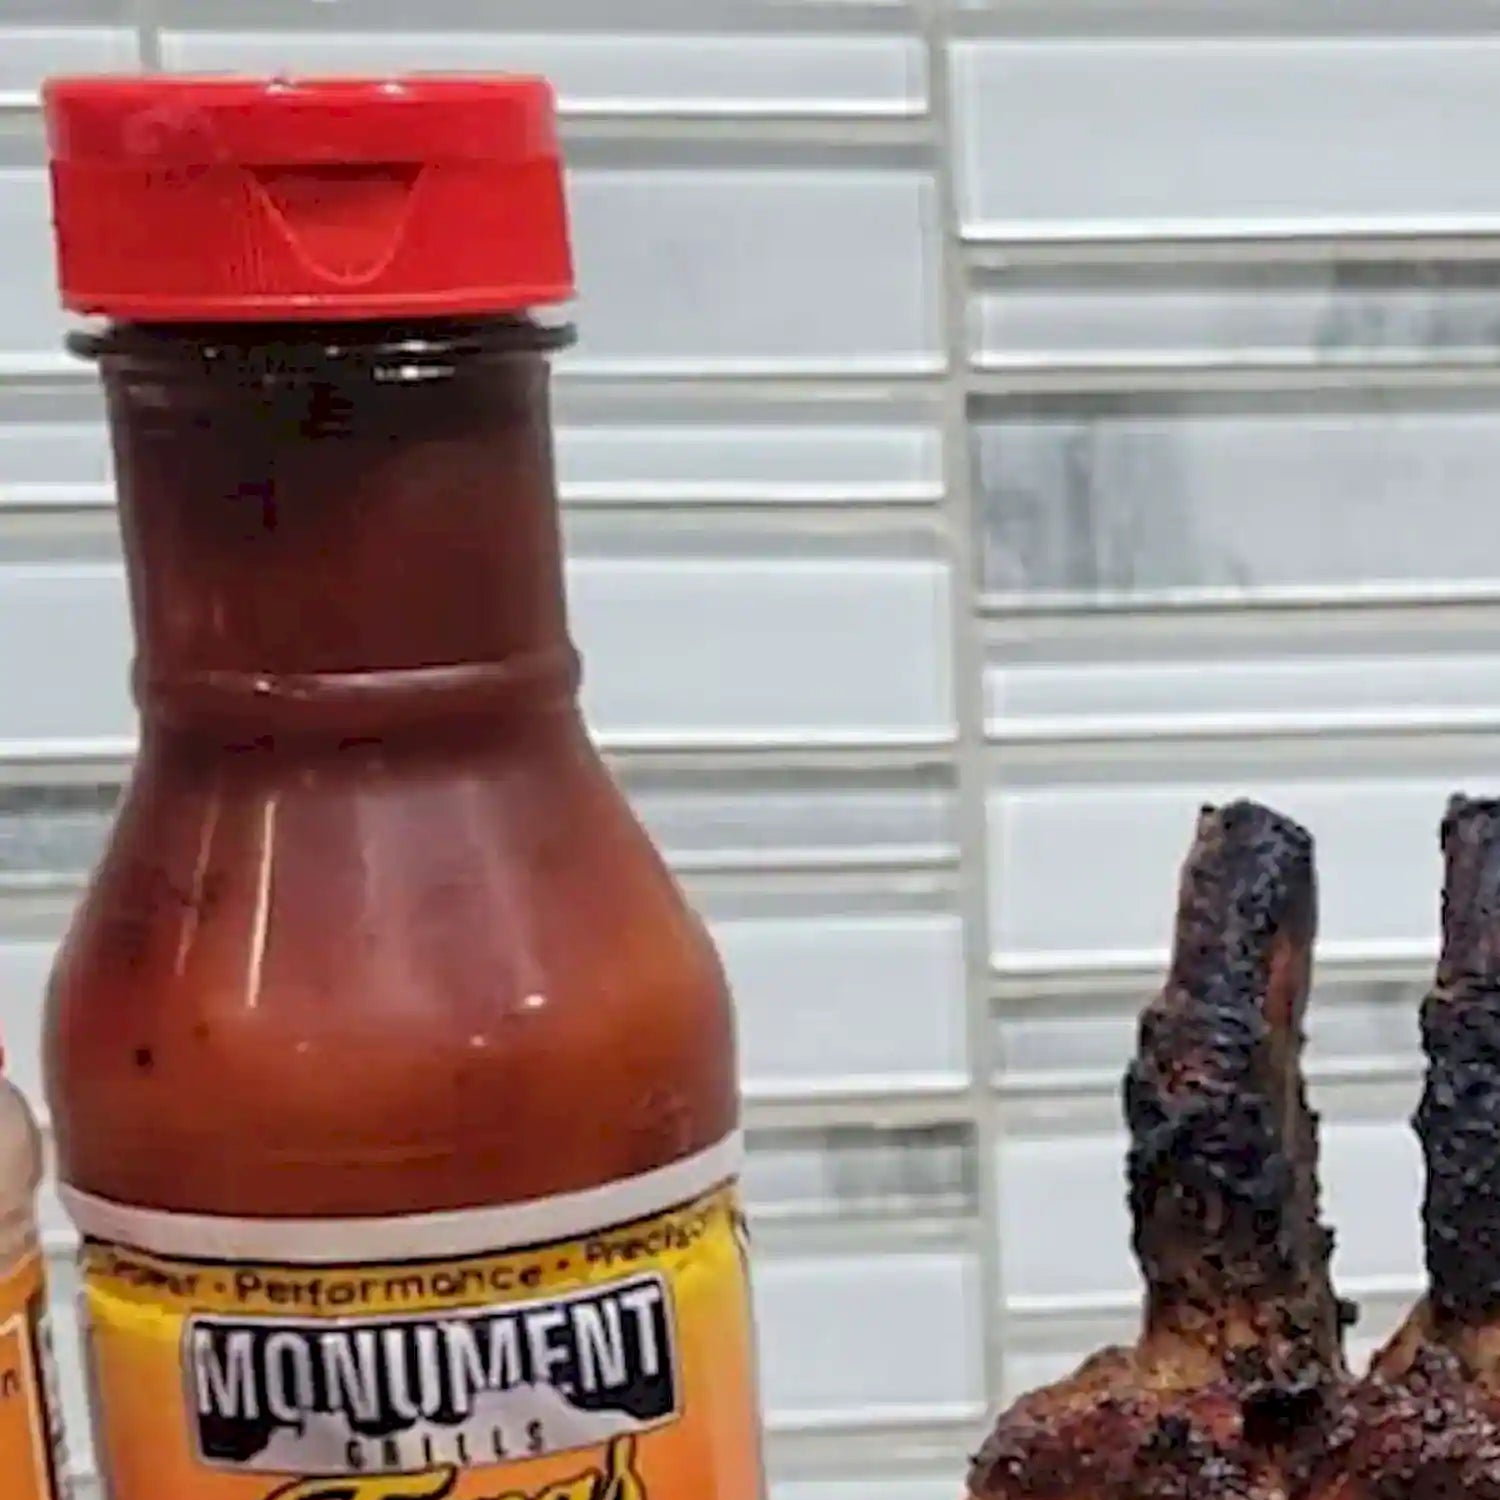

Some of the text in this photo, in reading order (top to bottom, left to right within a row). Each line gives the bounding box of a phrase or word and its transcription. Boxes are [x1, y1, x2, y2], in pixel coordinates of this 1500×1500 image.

[235, 1250, 545, 1308] Performance
[193, 1284, 667, 1424] MONUMENT
[345, 1418, 545, 1471] GRILLS
